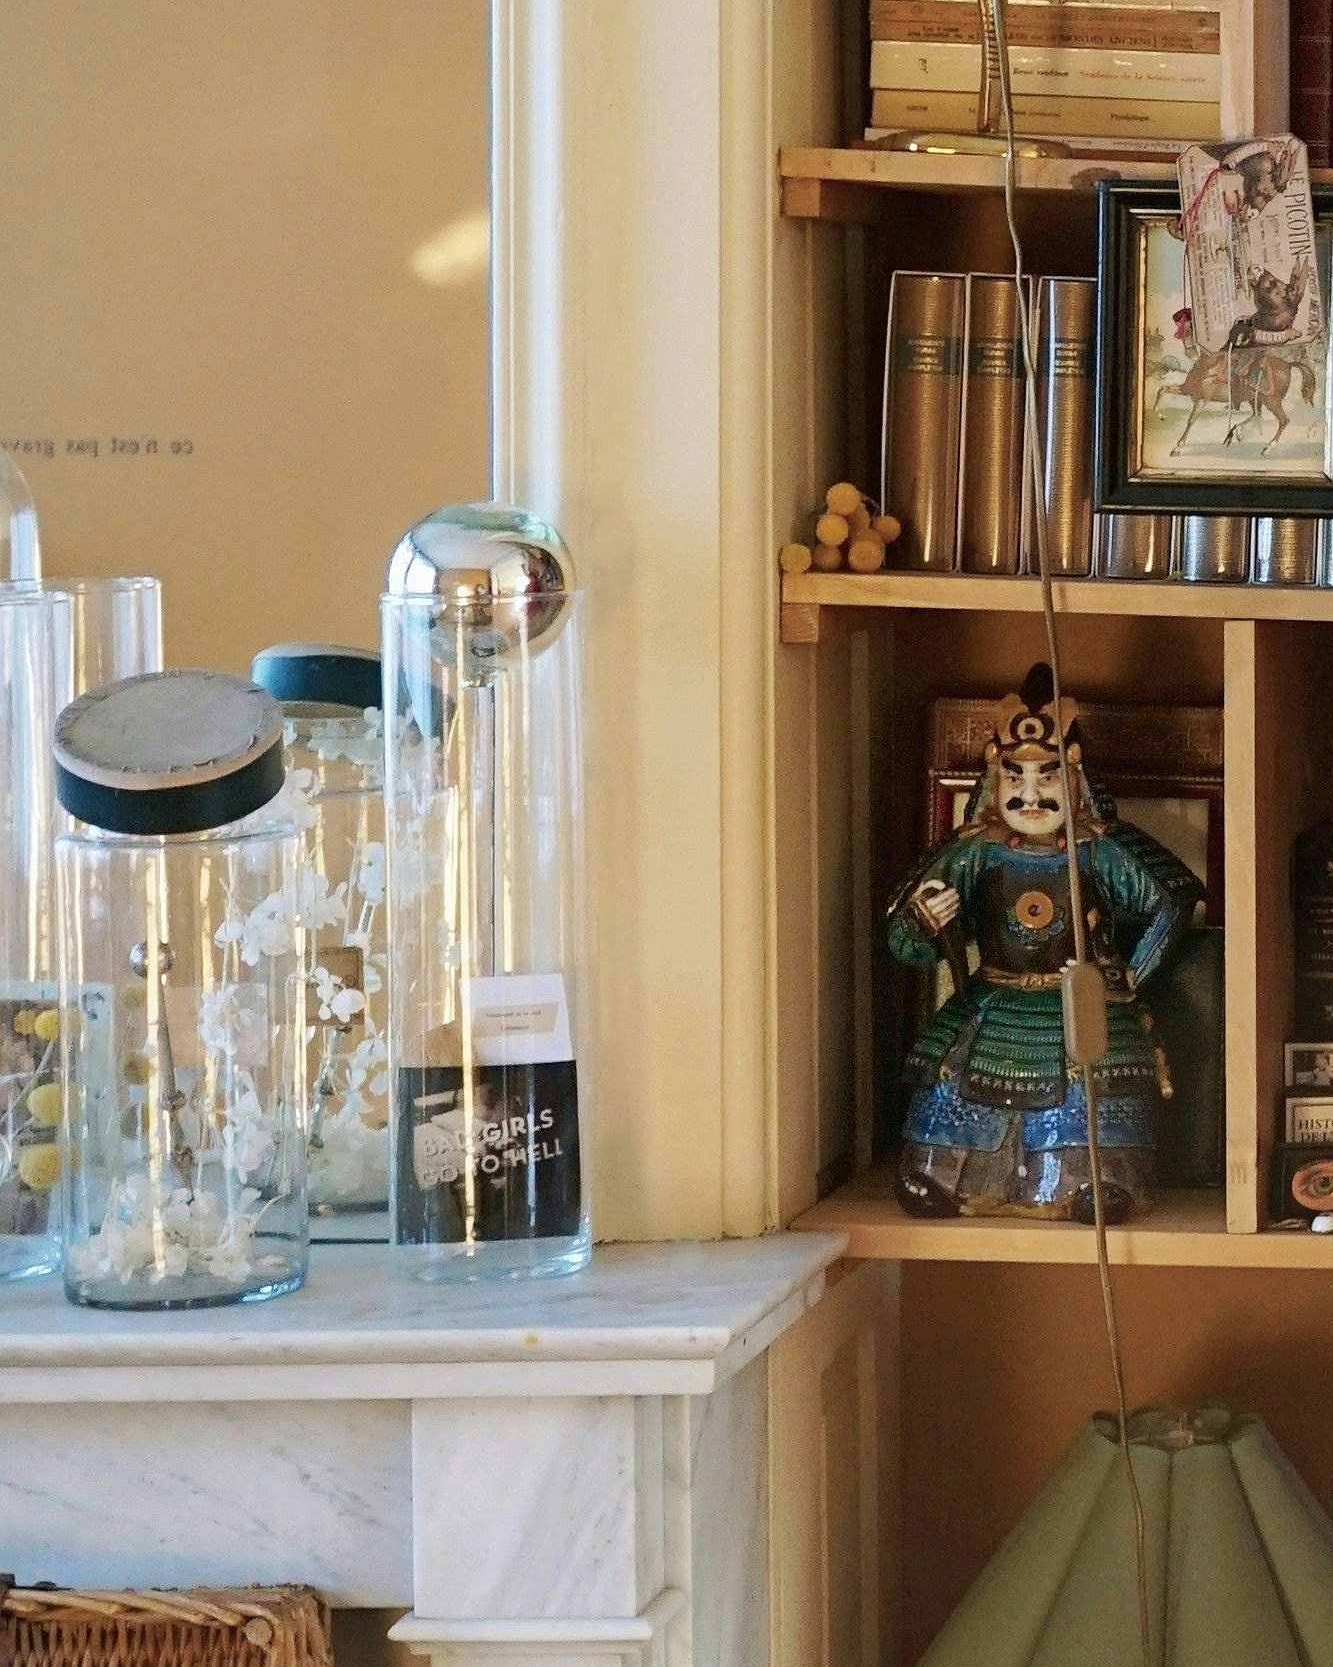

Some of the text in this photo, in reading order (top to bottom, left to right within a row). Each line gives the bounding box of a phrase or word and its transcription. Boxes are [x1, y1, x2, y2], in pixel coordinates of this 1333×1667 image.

[1284, 192, 1312, 256] PICOTIN
[481, 1108, 554, 1145] GIRLS
[470, 1154, 500, 1178] TO
[509, 1138, 565, 1168] HELL
